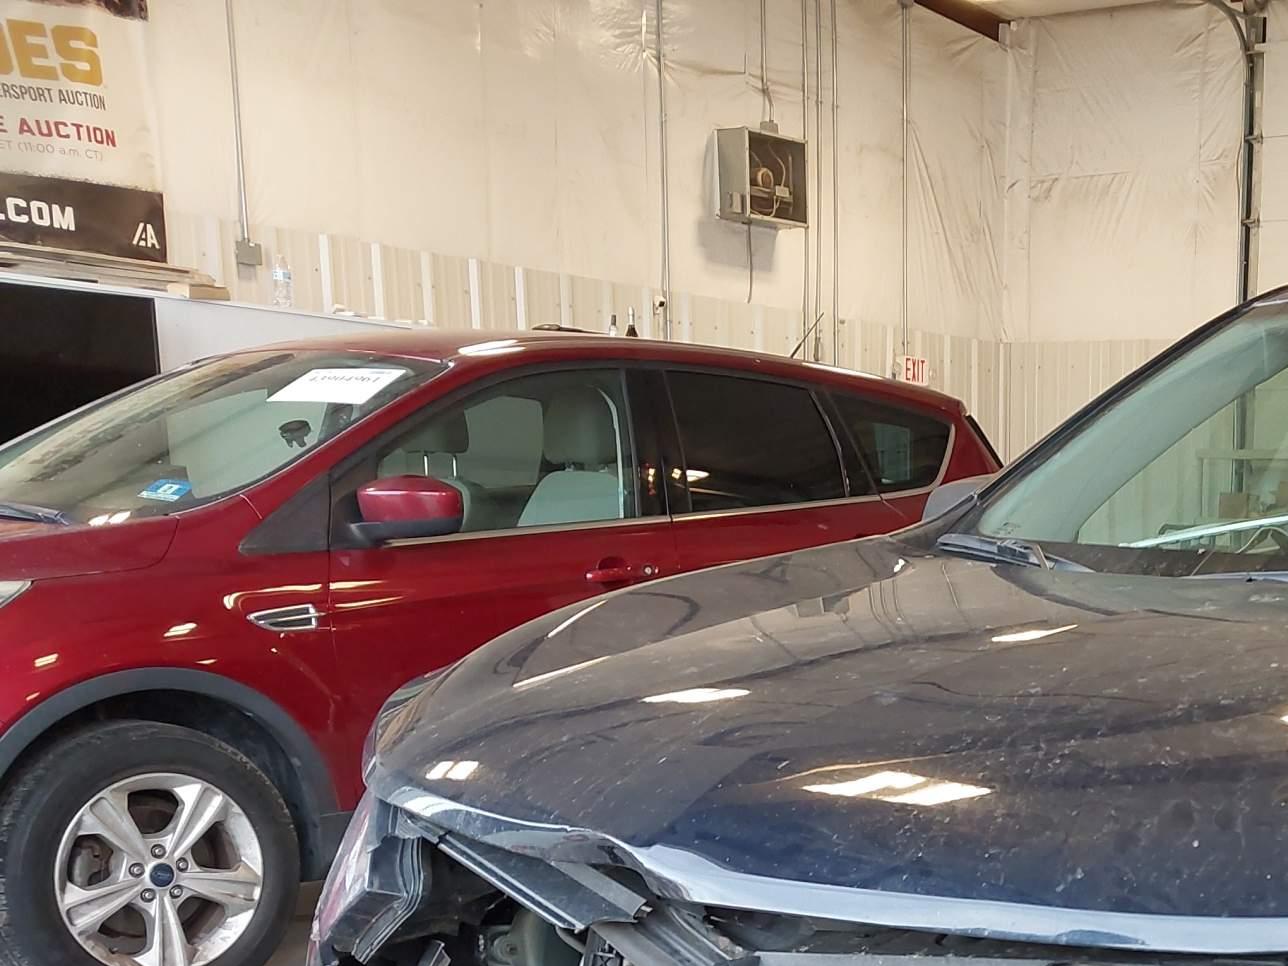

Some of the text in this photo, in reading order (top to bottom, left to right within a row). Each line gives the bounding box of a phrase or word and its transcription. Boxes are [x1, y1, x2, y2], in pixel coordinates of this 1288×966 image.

[57, 88, 107, 112] AUCTION
[18, 117, 117, 148] AUCTION
[905, 357, 926, 384] EXIT
